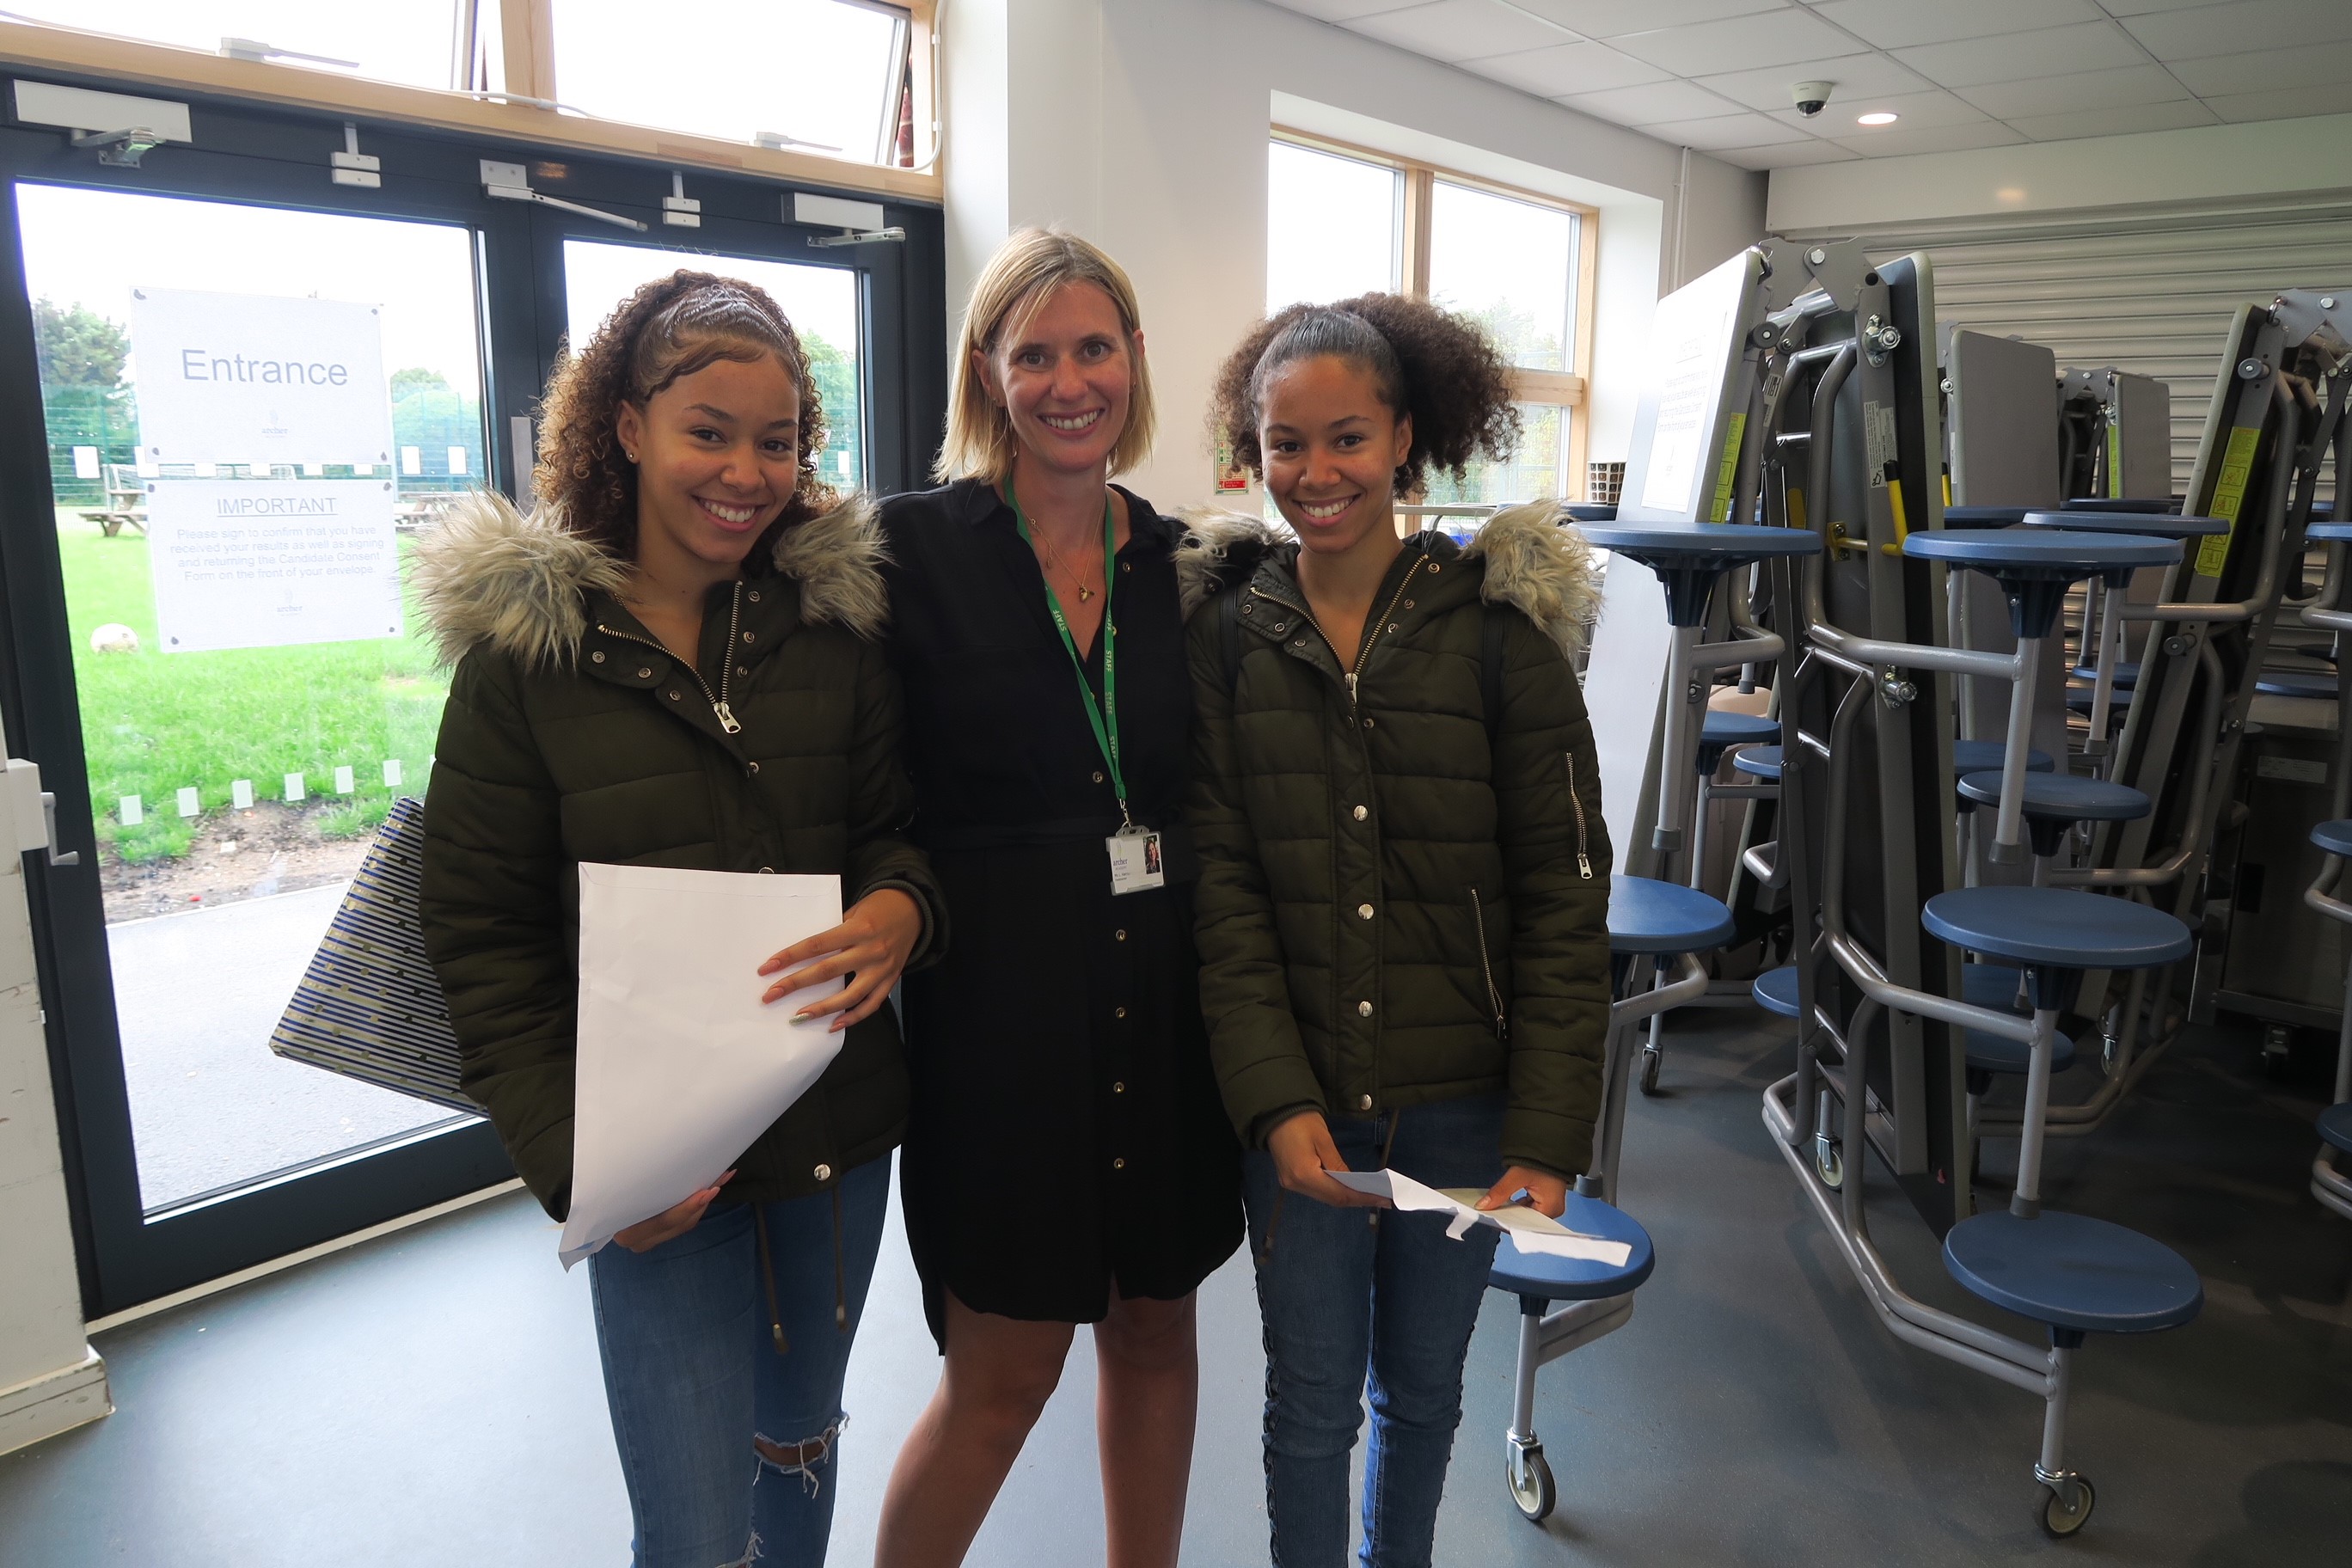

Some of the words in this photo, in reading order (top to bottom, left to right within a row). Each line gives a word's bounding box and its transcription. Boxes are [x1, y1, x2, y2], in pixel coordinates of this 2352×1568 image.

[181, 348, 348, 386] Entrance
[217, 498, 337, 514] IMPORTANT
[177, 529, 218, 540] Please
[221, 528, 243, 540] sign
[248, 529, 259, 538] to
[262, 526, 303, 538] confirm
[306, 526, 327, 536] that
[328, 528, 349, 540] you
[351, 525, 377, 536] have
[170, 543, 221, 554] received
[223, 543, 249, 555] your
[252, 541, 290, 551] results
[291, 542, 305, 551] as
[309, 539, 329, 549] well
[332, 541, 345, 549] as
[347, 538, 384, 551] signing
[178, 557, 200, 568] and
[204, 555, 255, 569] returning
[258, 554, 275, 565] the
[279, 553, 334, 564] Candidate
[336, 551, 380, 562] Consent
[184, 570, 216, 582] Form
[218, 572, 234, 580] on
[236, 569, 254, 579] the
[257, 567, 284, 578] front
[285, 567, 297, 577] of
[298, 567, 323, 579] your
[1052, 609, 1067, 632] STAFF
